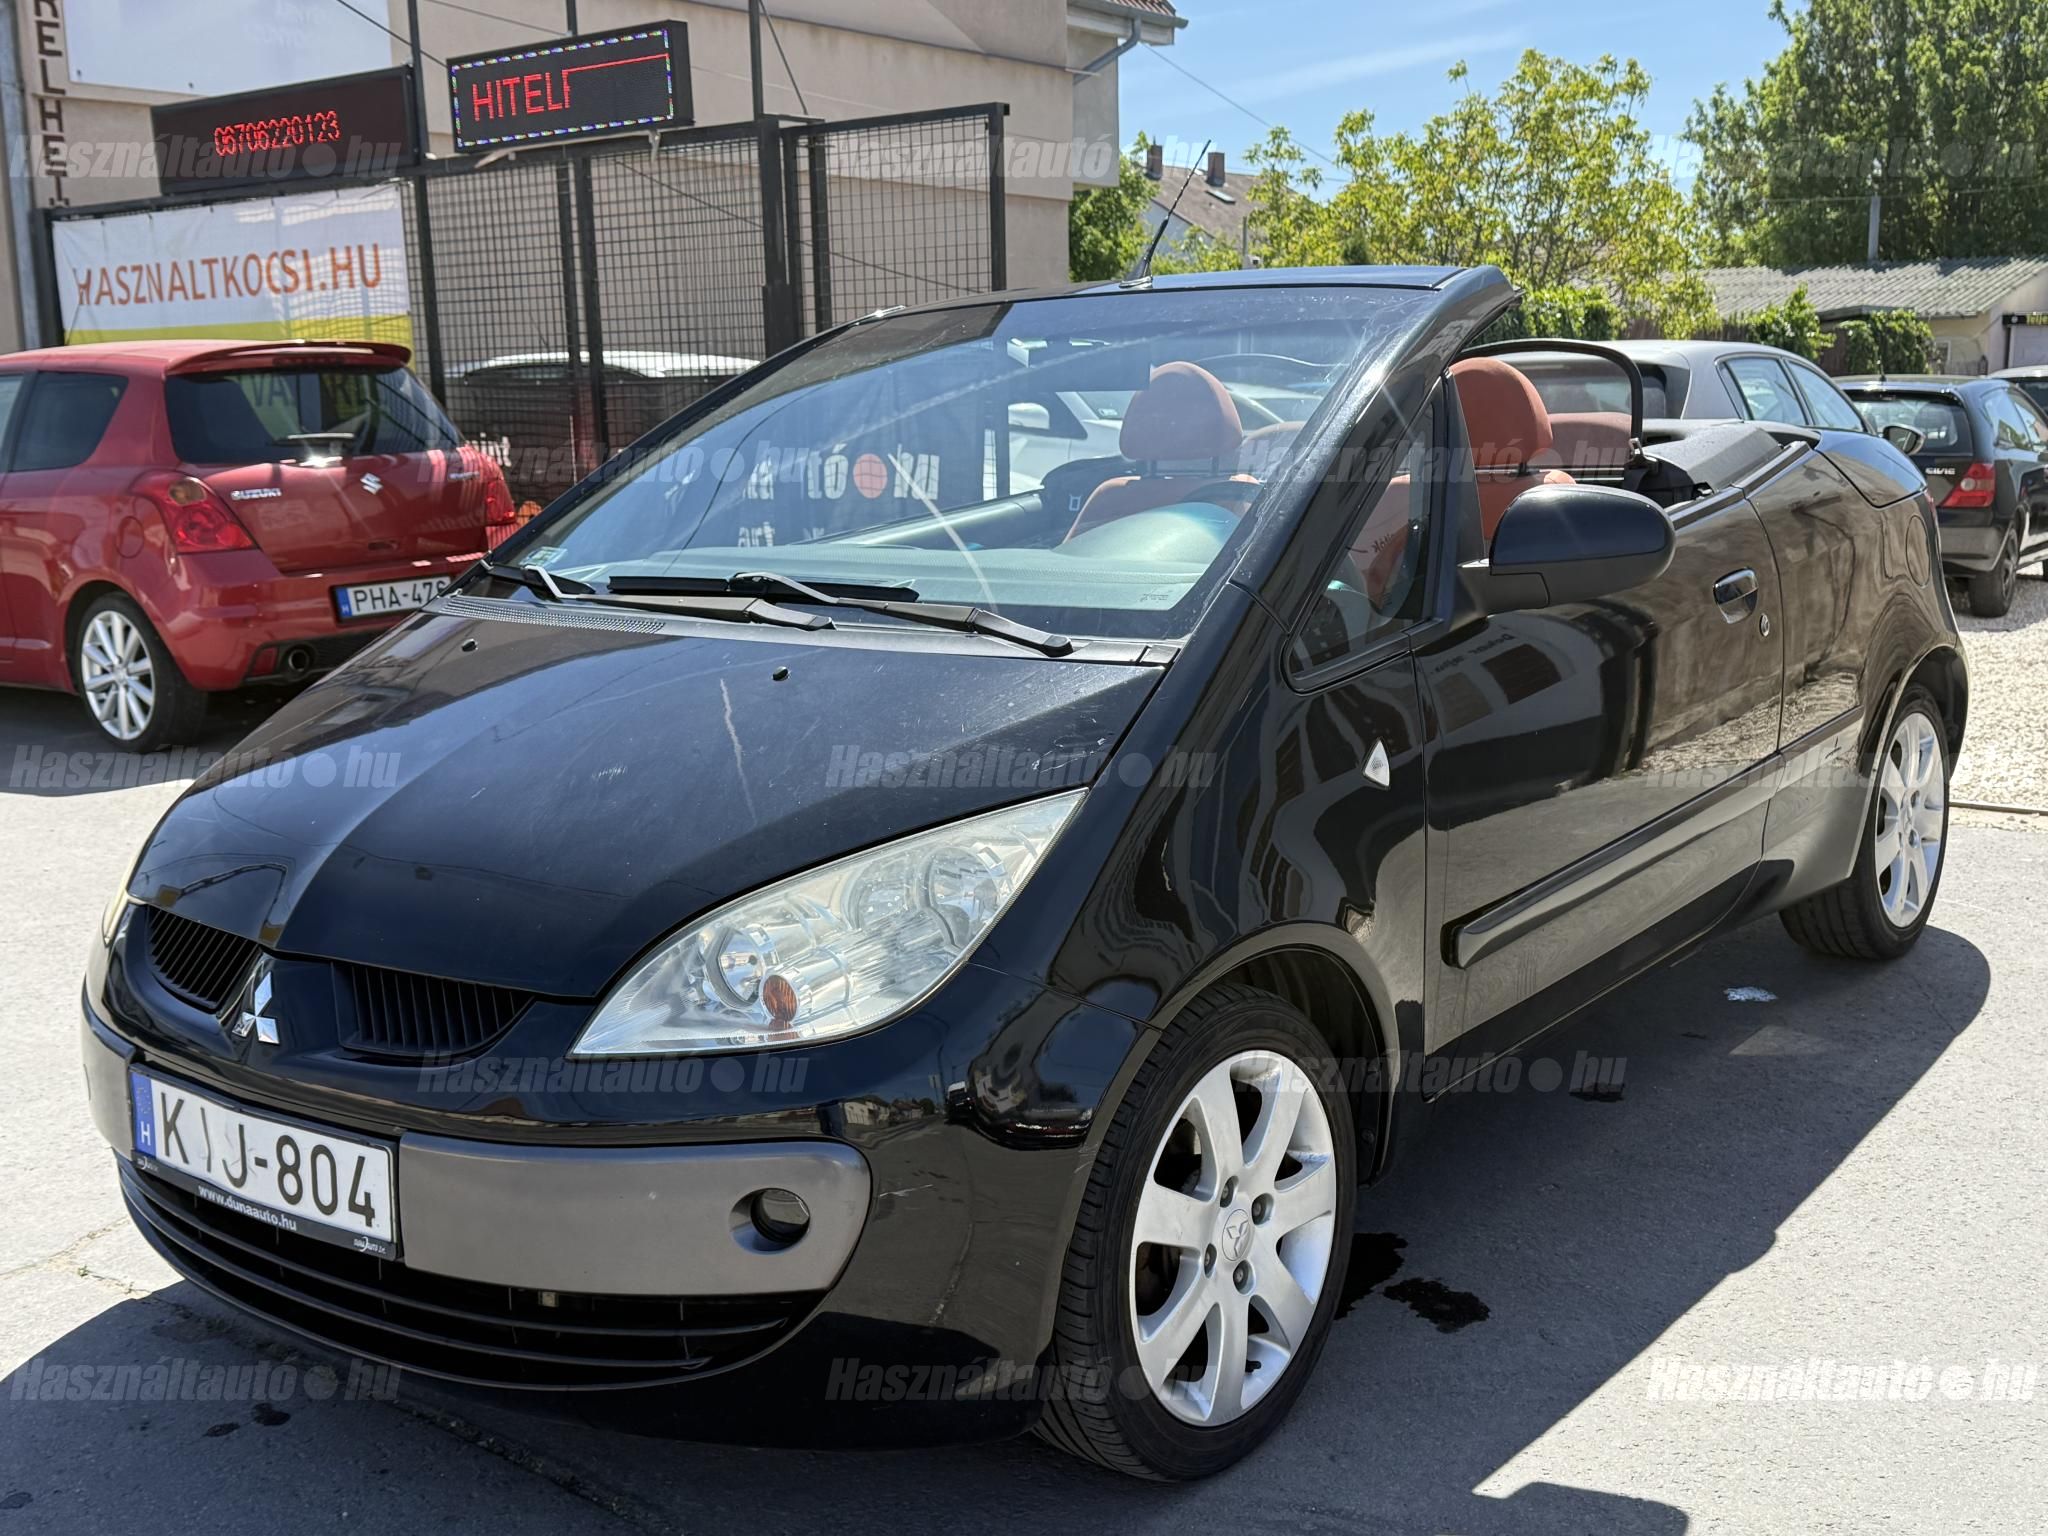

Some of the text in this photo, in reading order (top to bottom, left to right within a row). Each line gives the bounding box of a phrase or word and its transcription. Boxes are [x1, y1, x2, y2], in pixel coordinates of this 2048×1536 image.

[73, 243, 382, 306] HASZNALTKOCSI.HU
[231, 487, 282, 500] SUZUKI
[139, 1120, 152, 1147] H
[197, 1184, 297, 1232] www.dunaauto.hu
